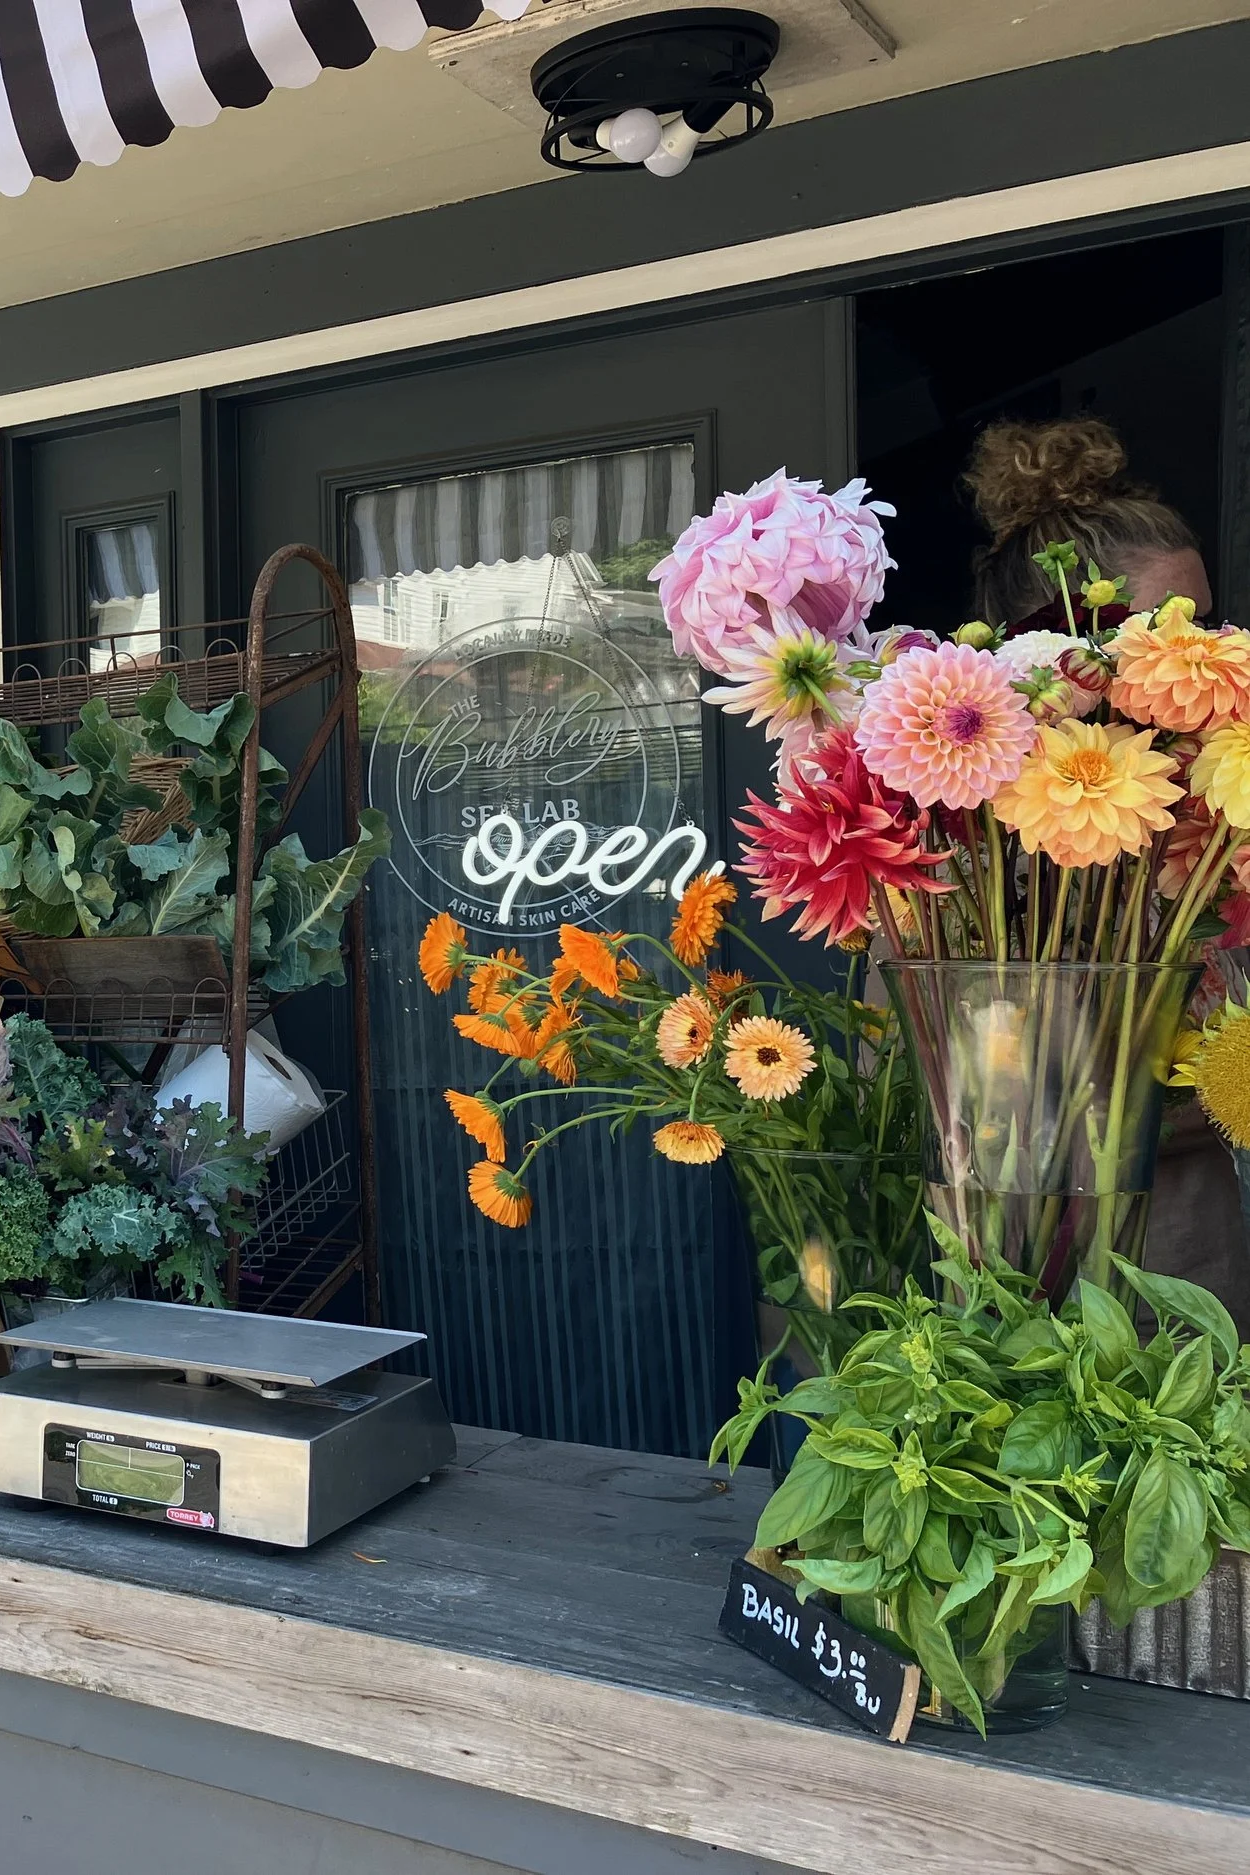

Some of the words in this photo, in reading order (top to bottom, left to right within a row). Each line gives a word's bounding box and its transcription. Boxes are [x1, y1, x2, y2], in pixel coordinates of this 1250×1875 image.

[449, 695, 480, 718] THE
[401, 691, 641, 800] Bubblery
[523, 799, 581, 824] LAB
[462, 813, 726, 924] open
[519, 909, 557, 926] SKIN
[560, 891, 601, 917] CARE
[86, 1431, 106, 1440] WEIGHT
[145, 1441, 161, 1450] PRICE
[92, 1494, 108, 1504] TOTAL
[169, 1510, 199, 1522] TORREY
[741, 1583, 800, 1649] BASIL
[854, 1681, 881, 1715] BU
